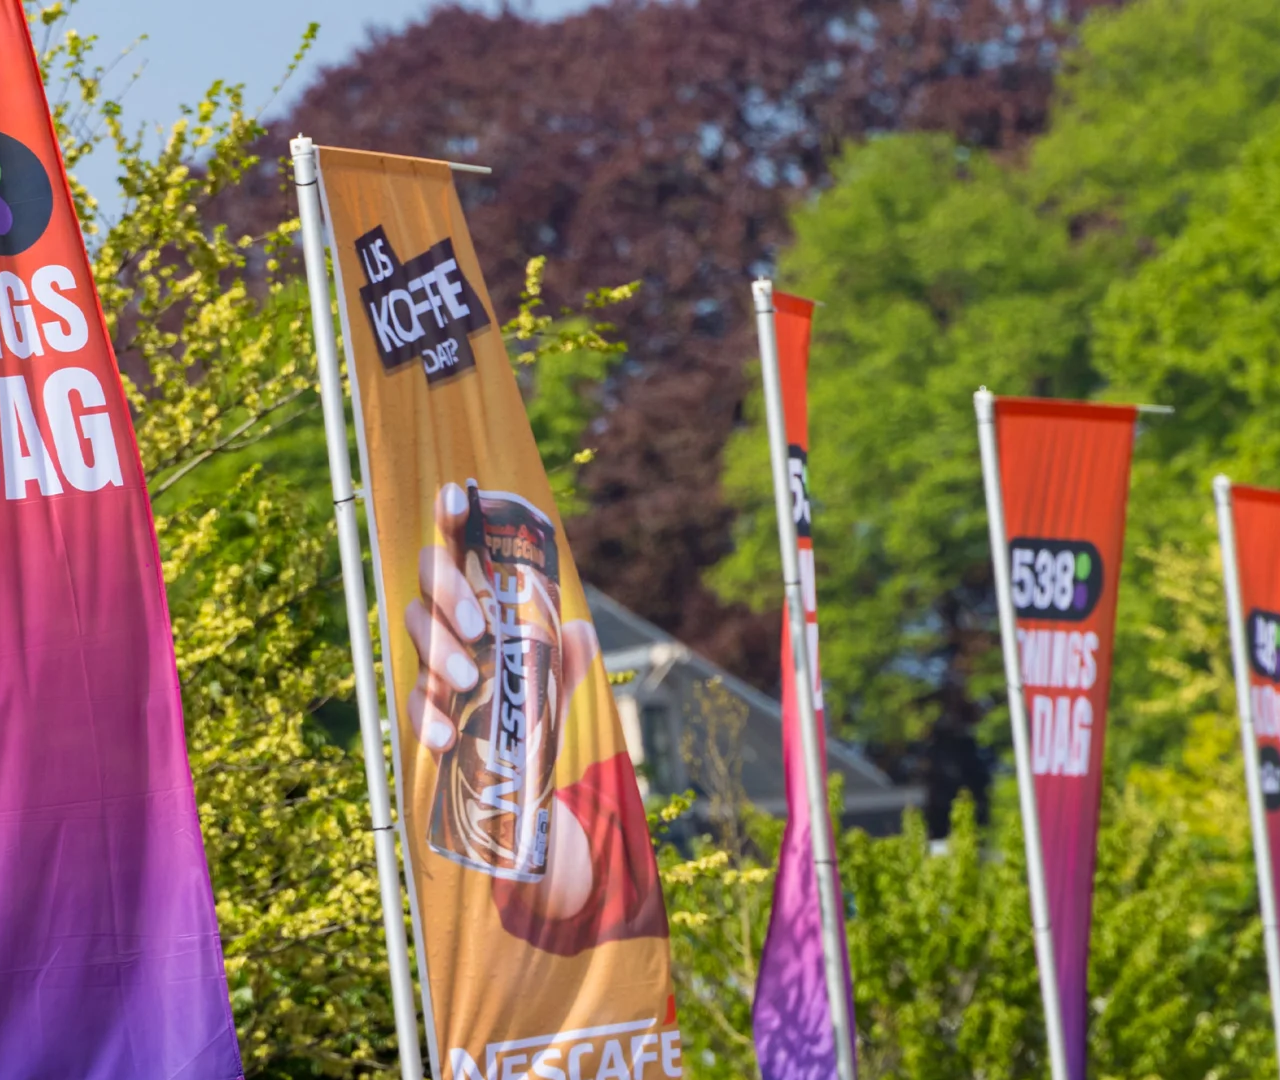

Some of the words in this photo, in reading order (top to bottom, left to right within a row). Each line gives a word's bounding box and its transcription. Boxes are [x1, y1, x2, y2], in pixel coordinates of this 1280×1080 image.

[422, 338, 459, 374] DAT?
[1012, 548, 1076, 611] 538
[1018, 628, 1099, 690] NINGS
[1032, 695, 1094, 777] DAG
